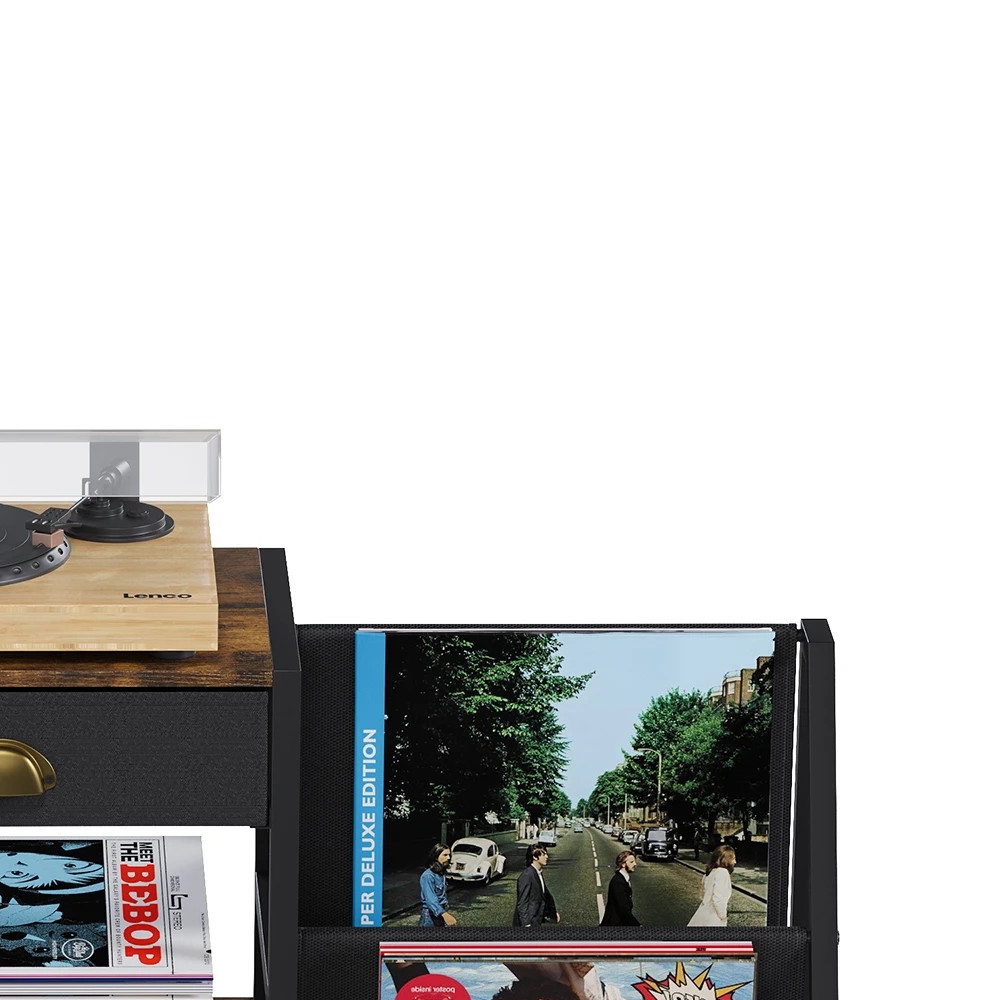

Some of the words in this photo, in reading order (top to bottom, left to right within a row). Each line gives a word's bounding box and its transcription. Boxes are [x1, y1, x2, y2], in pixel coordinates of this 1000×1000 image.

[362, 729, 377, 808] EDITION
[120, 842, 139, 862] THE
[139, 842, 154, 863] MEET
[361, 813, 376, 887] DELUXE
[120, 864, 162, 965] BEBOP
[173, 911, 183, 930] STEREO
[361, 891, 375, 925] PER
